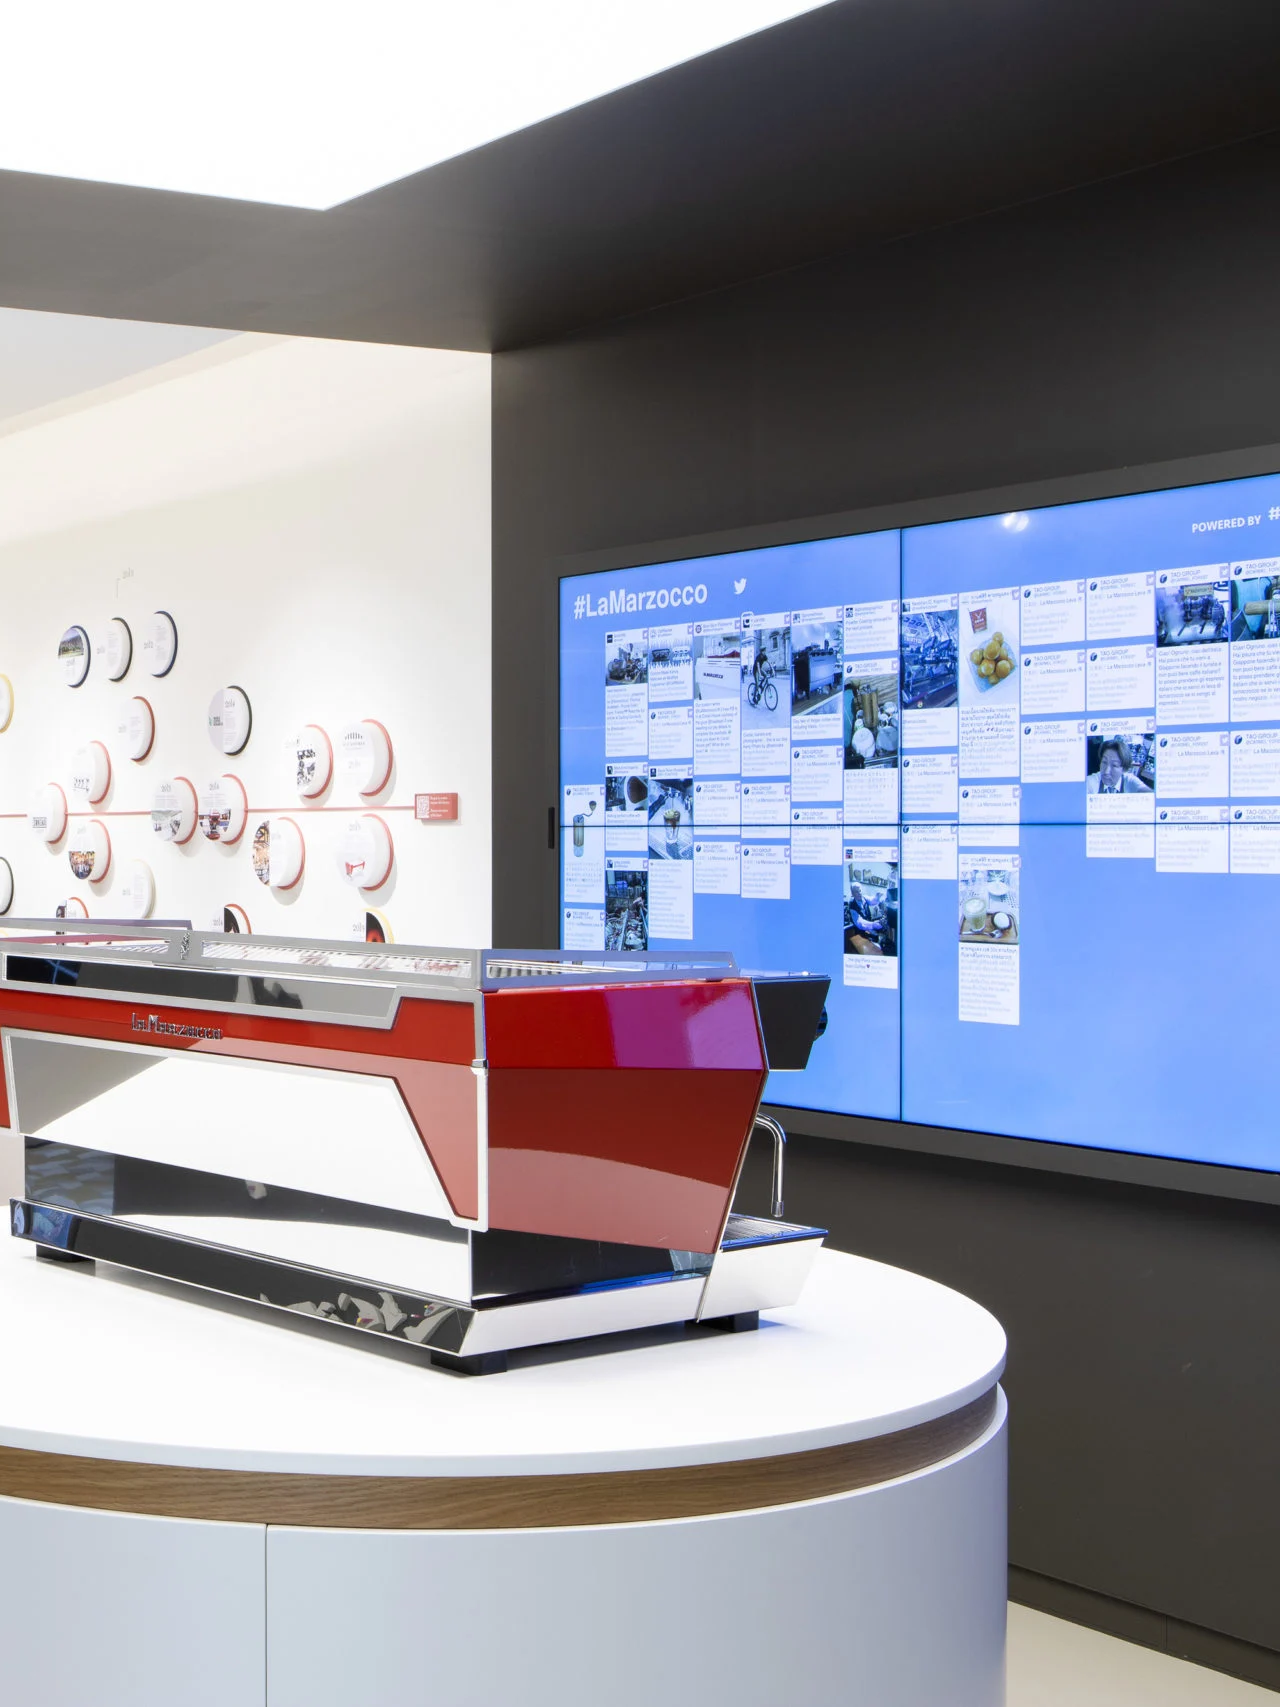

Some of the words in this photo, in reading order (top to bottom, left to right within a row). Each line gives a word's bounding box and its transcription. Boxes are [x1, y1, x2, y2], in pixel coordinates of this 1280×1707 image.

[1191, 517, 1246, 534] POWERED
[1247, 514, 1262, 527] BY
[573, 583, 709, 620] #LaMarzocco
